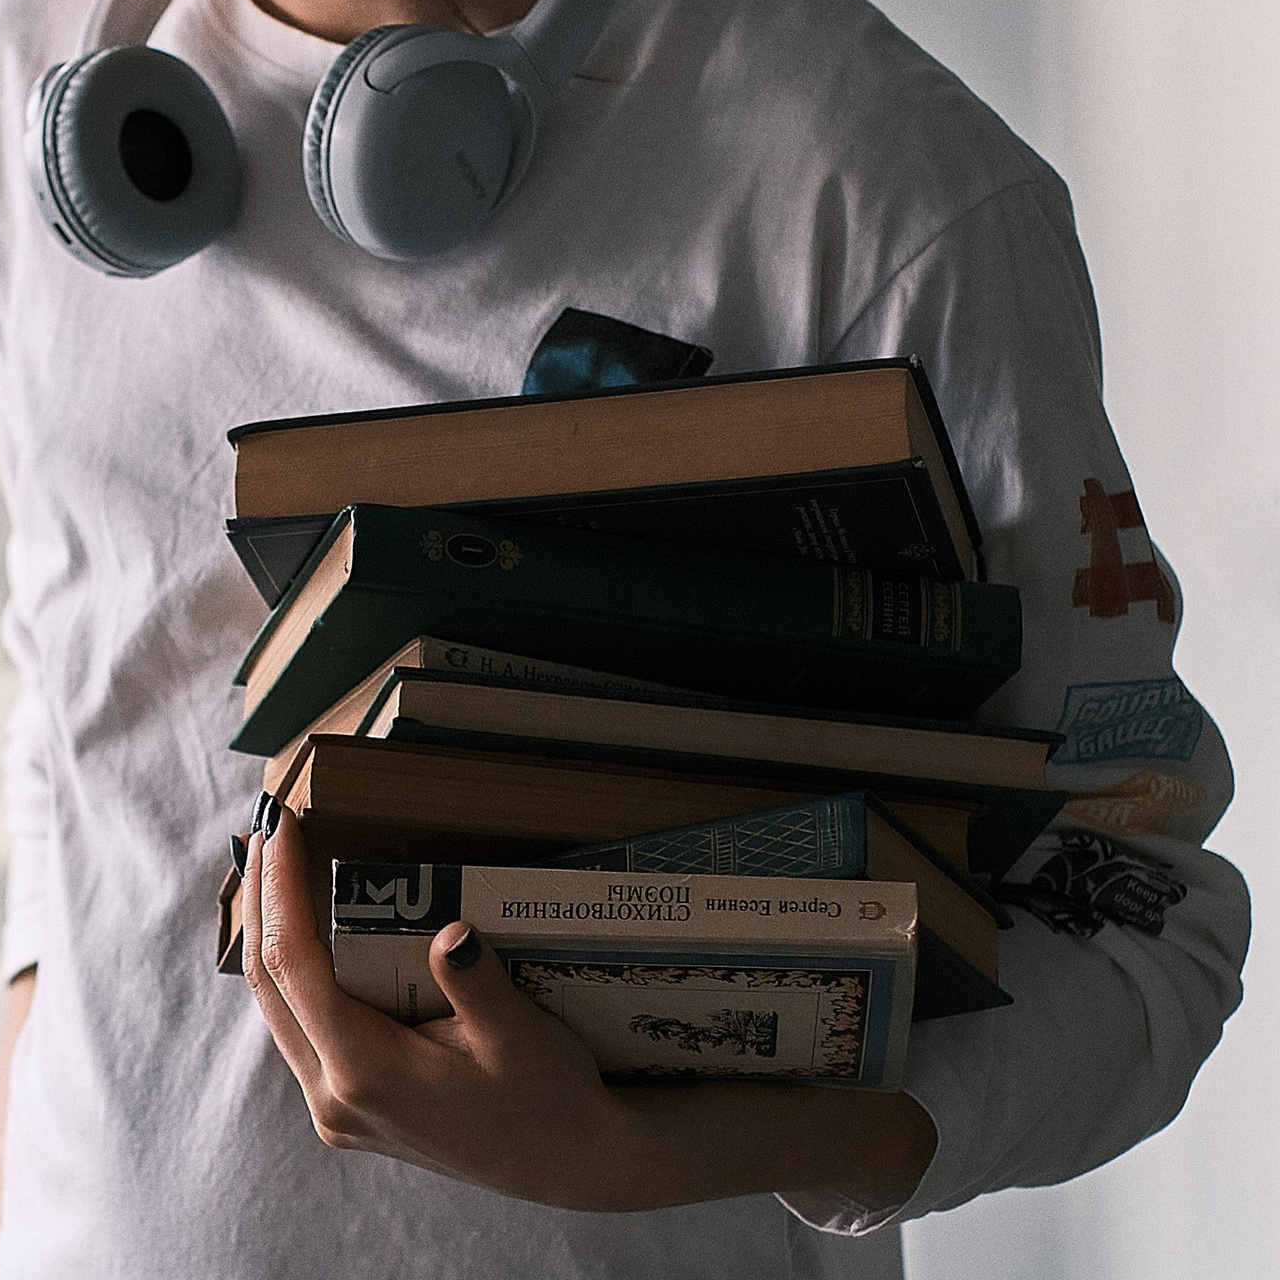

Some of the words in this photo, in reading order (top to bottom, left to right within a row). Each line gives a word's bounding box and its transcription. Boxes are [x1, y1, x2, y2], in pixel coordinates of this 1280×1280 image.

[882, 581, 894, 634] ЕСЕНИН
[898, 582, 910, 636] СЕРГЕЙ
[480, 658, 498, 673] Н.
[502, 661, 519, 678] А.
[607, 884, 691, 904] ПОЭМЫ
[1126, 879, 1158, 903] Keep
[501, 901, 691, 922] СТИХОТВОРЕНИЯ
[706, 898, 771, 916] Есенин
[778, 897, 843, 918] Сергей
